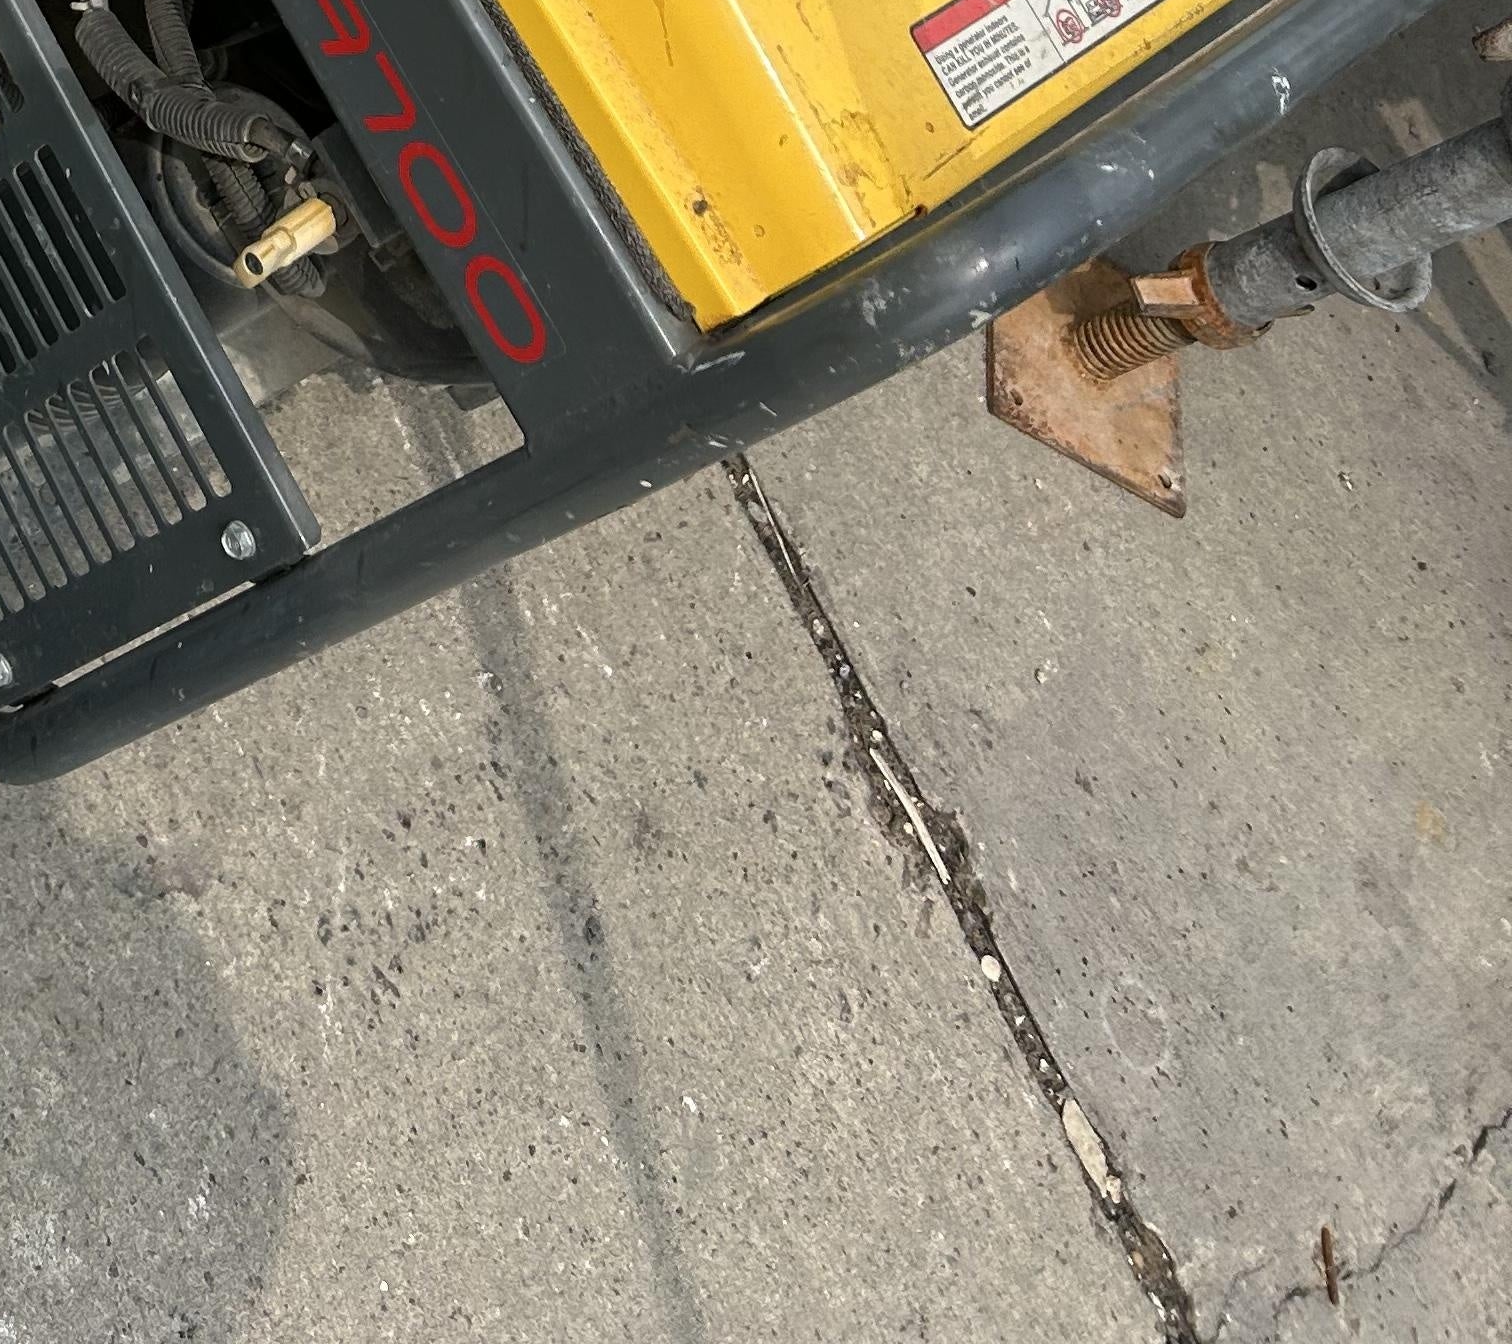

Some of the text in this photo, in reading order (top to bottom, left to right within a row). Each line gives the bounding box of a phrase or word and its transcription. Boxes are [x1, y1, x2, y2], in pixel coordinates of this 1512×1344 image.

[939, 59, 958, 76] CAN
[954, 51, 971, 67] KILL
[968, 42, 985, 58] YOU
[946, 62, 979, 87] Generator
